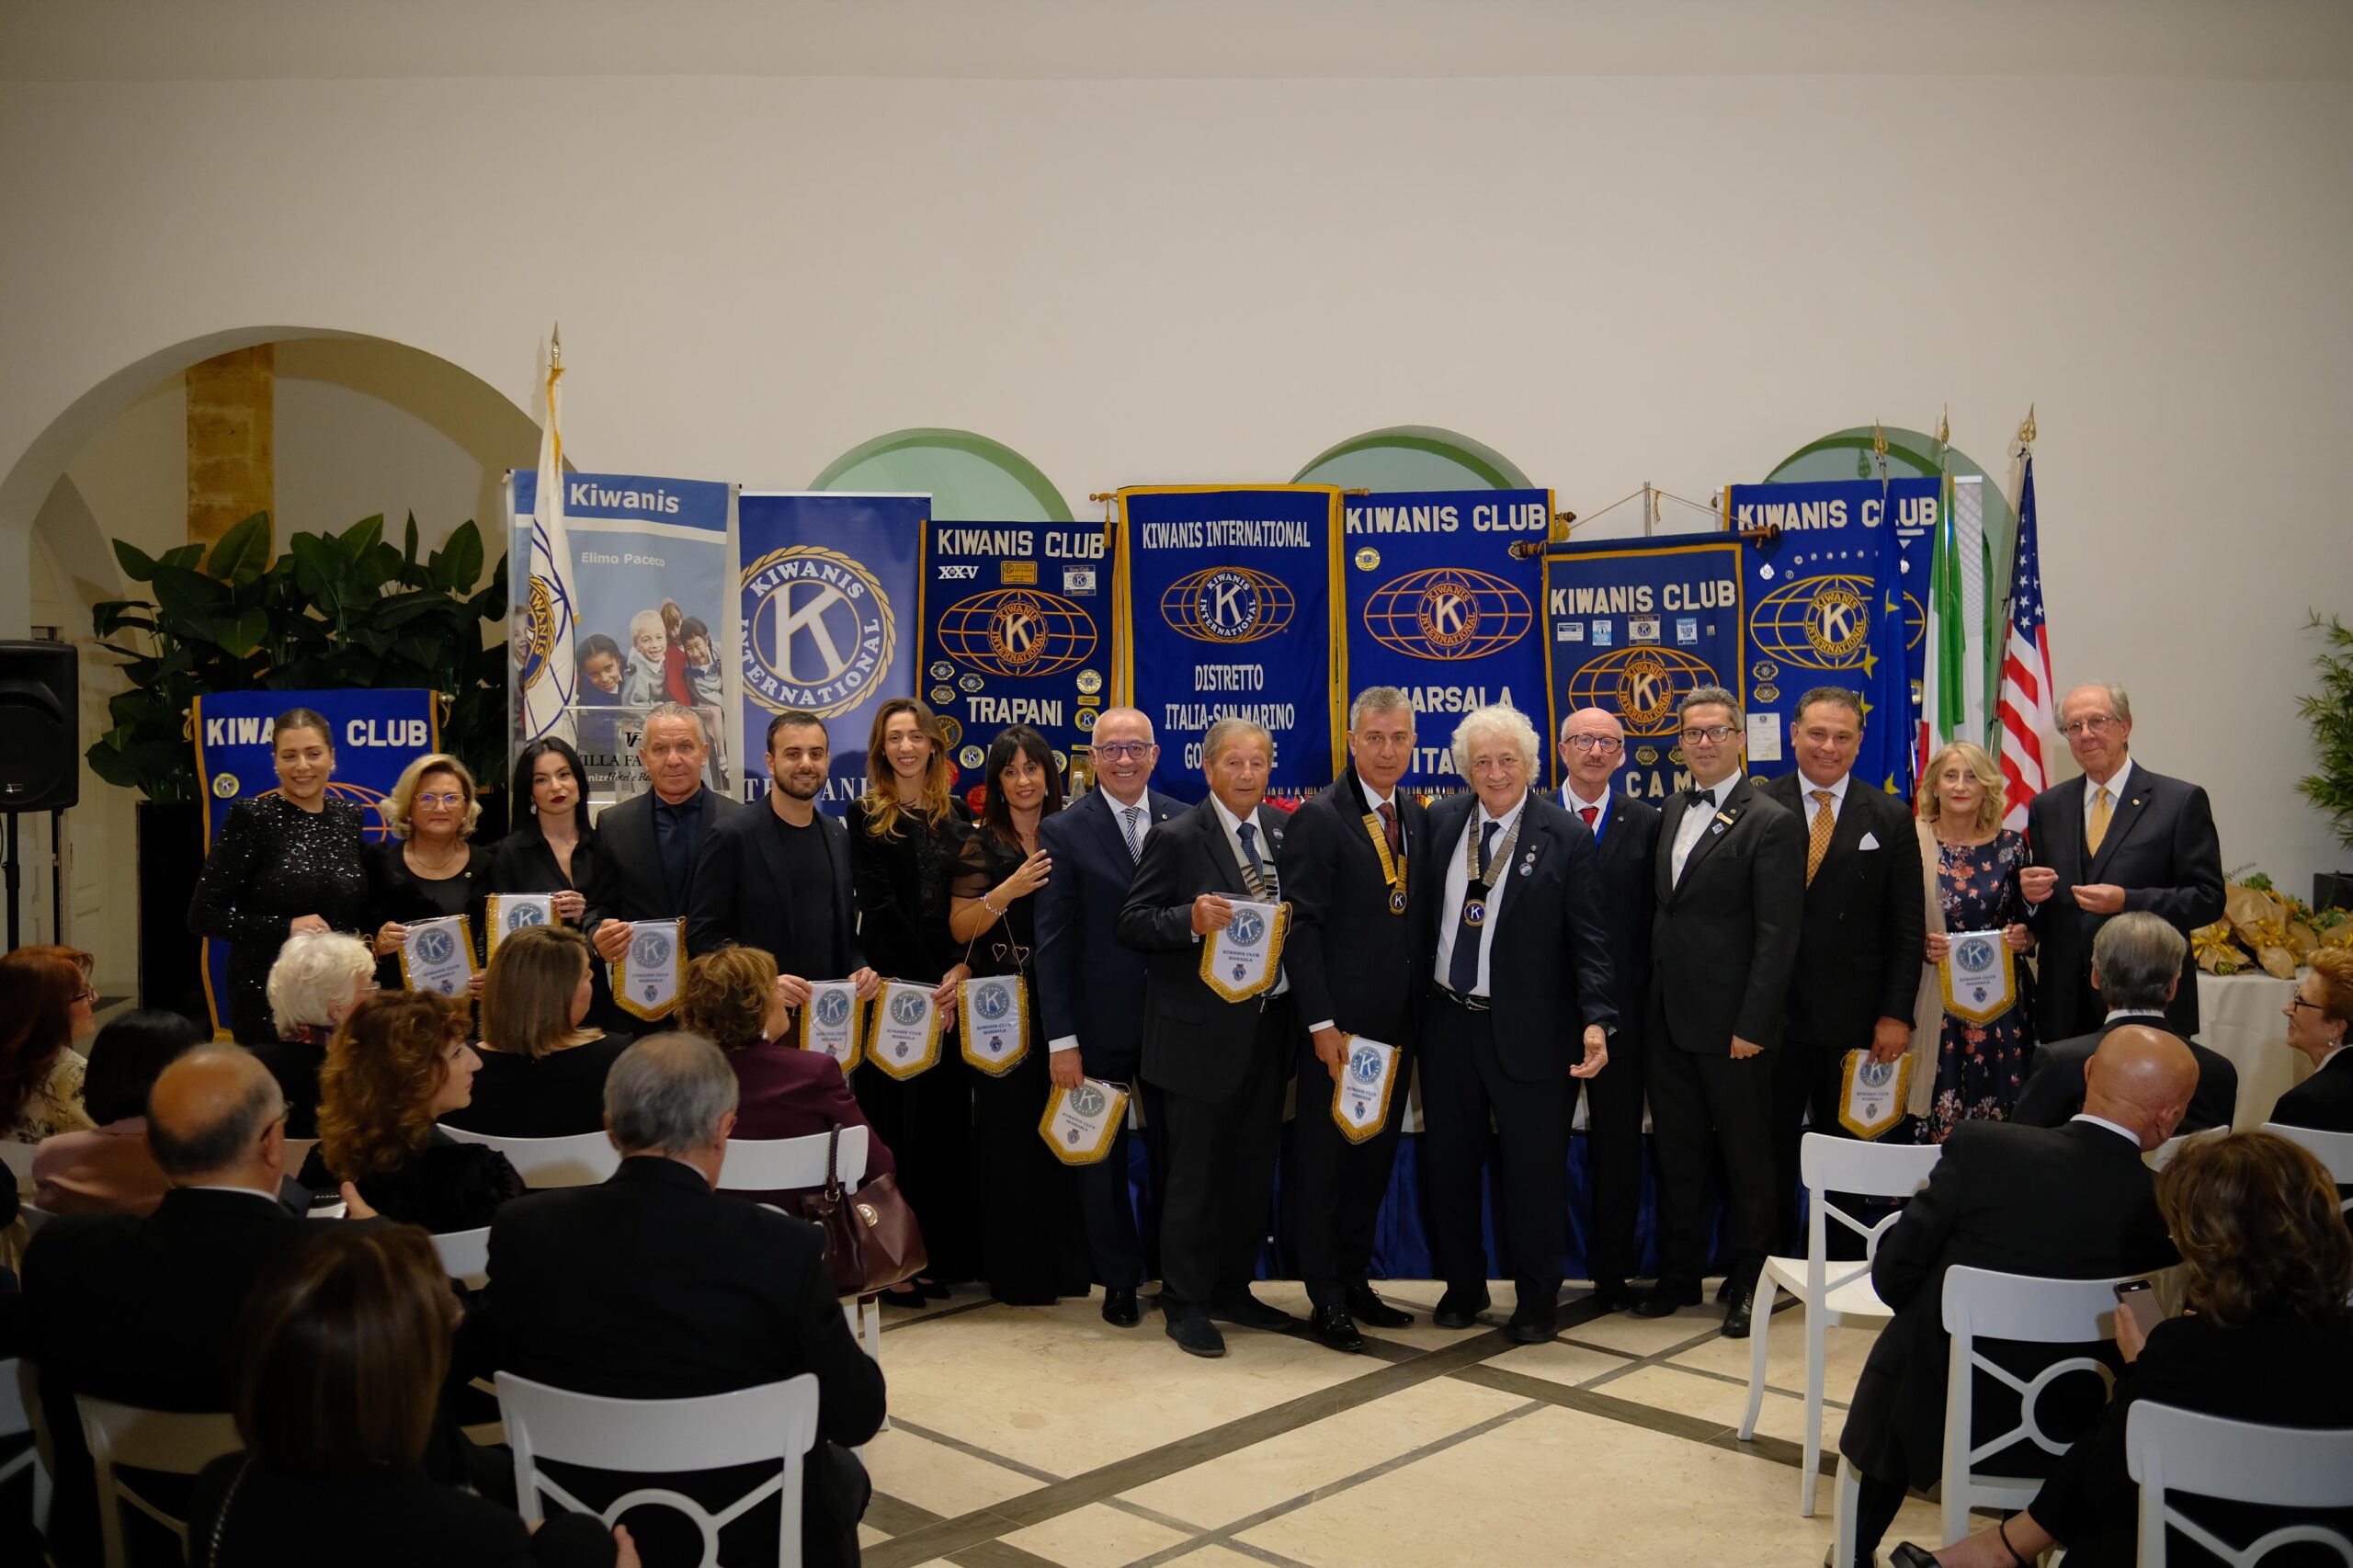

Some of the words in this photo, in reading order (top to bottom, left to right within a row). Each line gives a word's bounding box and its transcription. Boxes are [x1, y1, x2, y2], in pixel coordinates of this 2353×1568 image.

[571, 483, 679, 514] Kiwanis
[1346, 506, 1459, 533] KIWANIS
[1473, 504, 1546, 532] CLUB
[1738, 499, 1847, 530] KIWANIS
[938, 529, 1034, 556] KIWANIS
[1045, 531, 1105, 559] CLUB
[1142, 522, 1203, 549] KIWANIS
[1206, 520, 1311, 548] INTERNATIONAL
[581, 552, 619, 564] Elimo
[624, 553, 665, 568] Paceco
[750, 561, 865, 598] KIWANIS
[1207, 573, 1250, 591] KIWANIS
[1427, 585, 1471, 602] KIWANIS
[998, 604, 1039, 621] KIWANIS
[1551, 585, 1654, 616] KIWANIS
[1663, 580, 1735, 611] CLUB
[1813, 592, 1859, 610] KIWANIS
[529, 589, 547, 657] IWANIS
[1199, 598, 1256, 637] INTERNATIONAL
[1421, 611, 1475, 644] INTERNATIONAL
[993, 631, 1044, 662] INTERNATIONAL
[1808, 619, 1864, 653] INTERNATIONAL
[1195, 665, 1264, 691] DISTRETTO
[1626, 664, 1664, 680] KIWANIS
[967, 697, 1063, 726] TRAPANI
[1242, 703, 1295, 730] MARINO
[1620, 689, 1669, 722] INTERNATIONAL
[347, 720, 427, 746] CLUB
[744, 778, 868, 801] TANI
